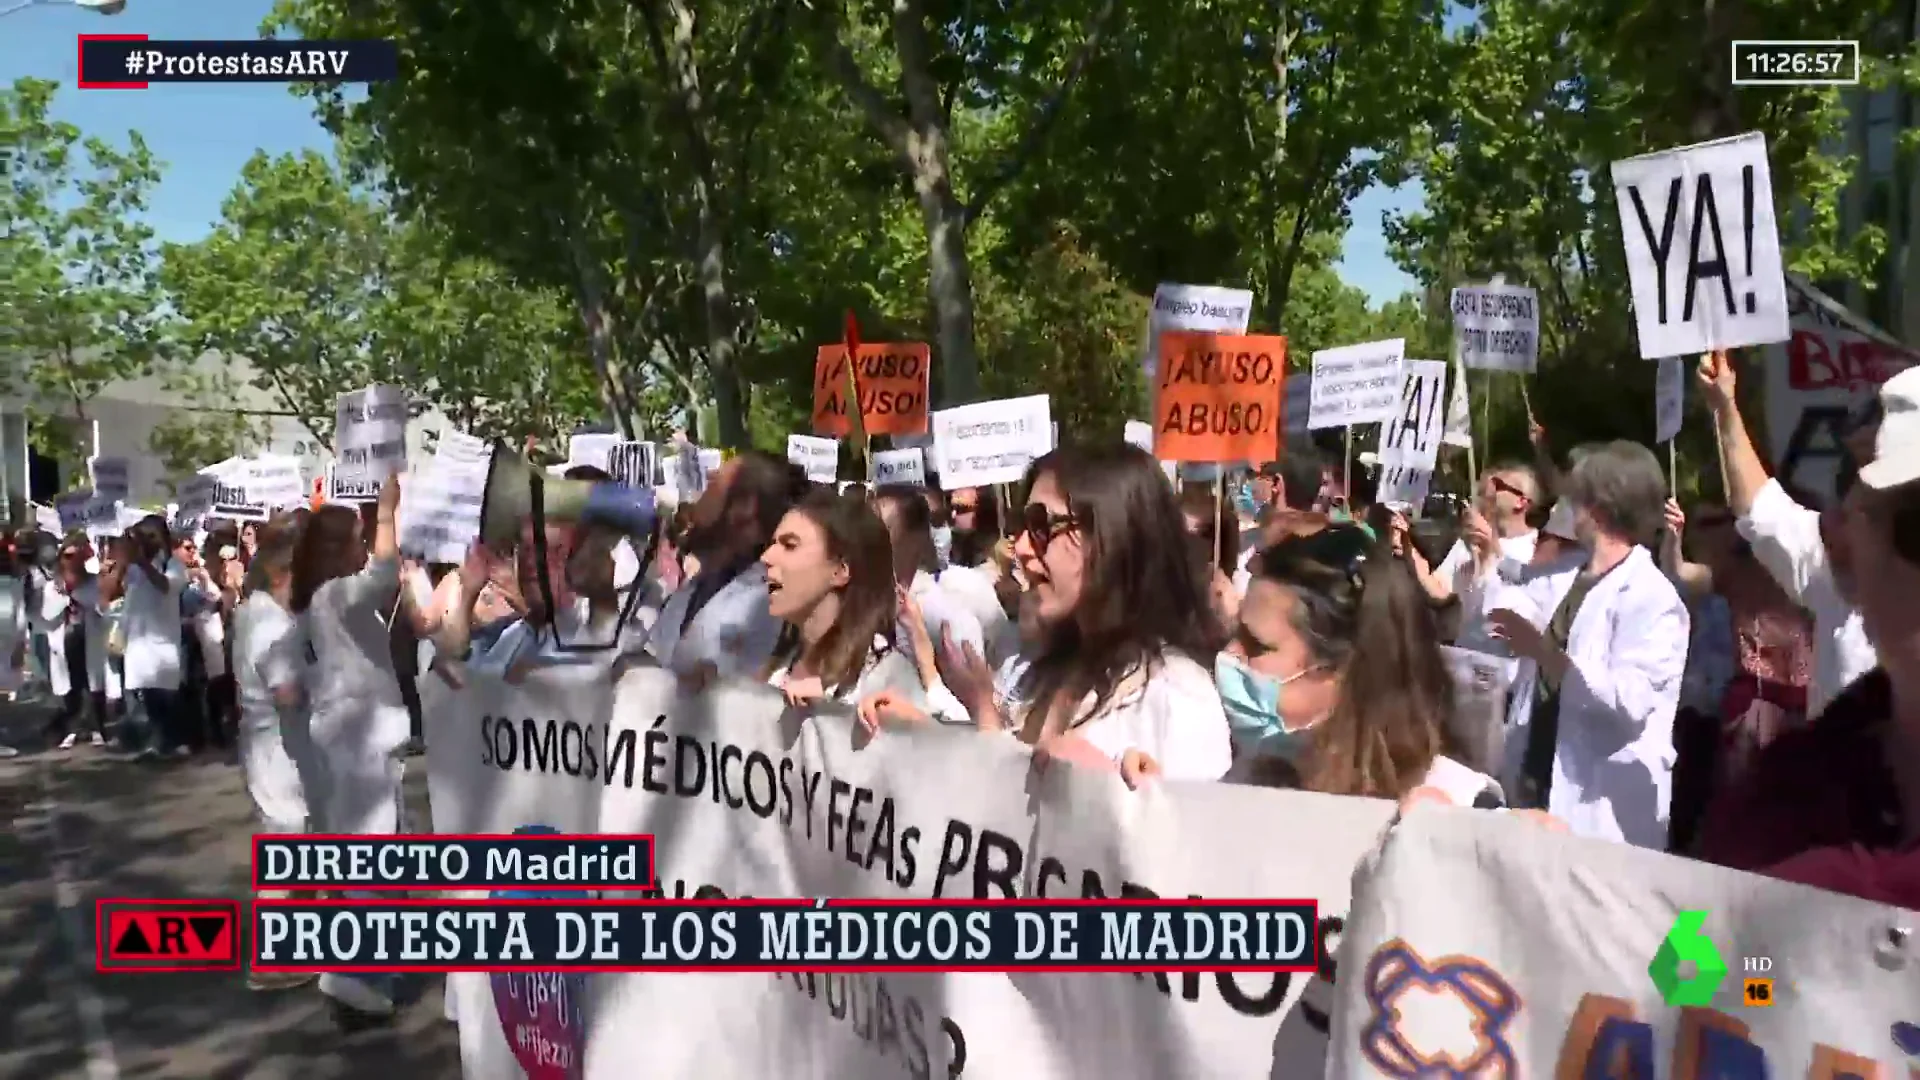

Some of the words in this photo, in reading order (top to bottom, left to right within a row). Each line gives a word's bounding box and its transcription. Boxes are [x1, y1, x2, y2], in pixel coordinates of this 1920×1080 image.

[1628, 165, 1756, 324] YA!
[818, 390, 922, 416] AUSO!
[481, 713, 599, 780] SOMOS
[801, 766, 822, 841] Y
